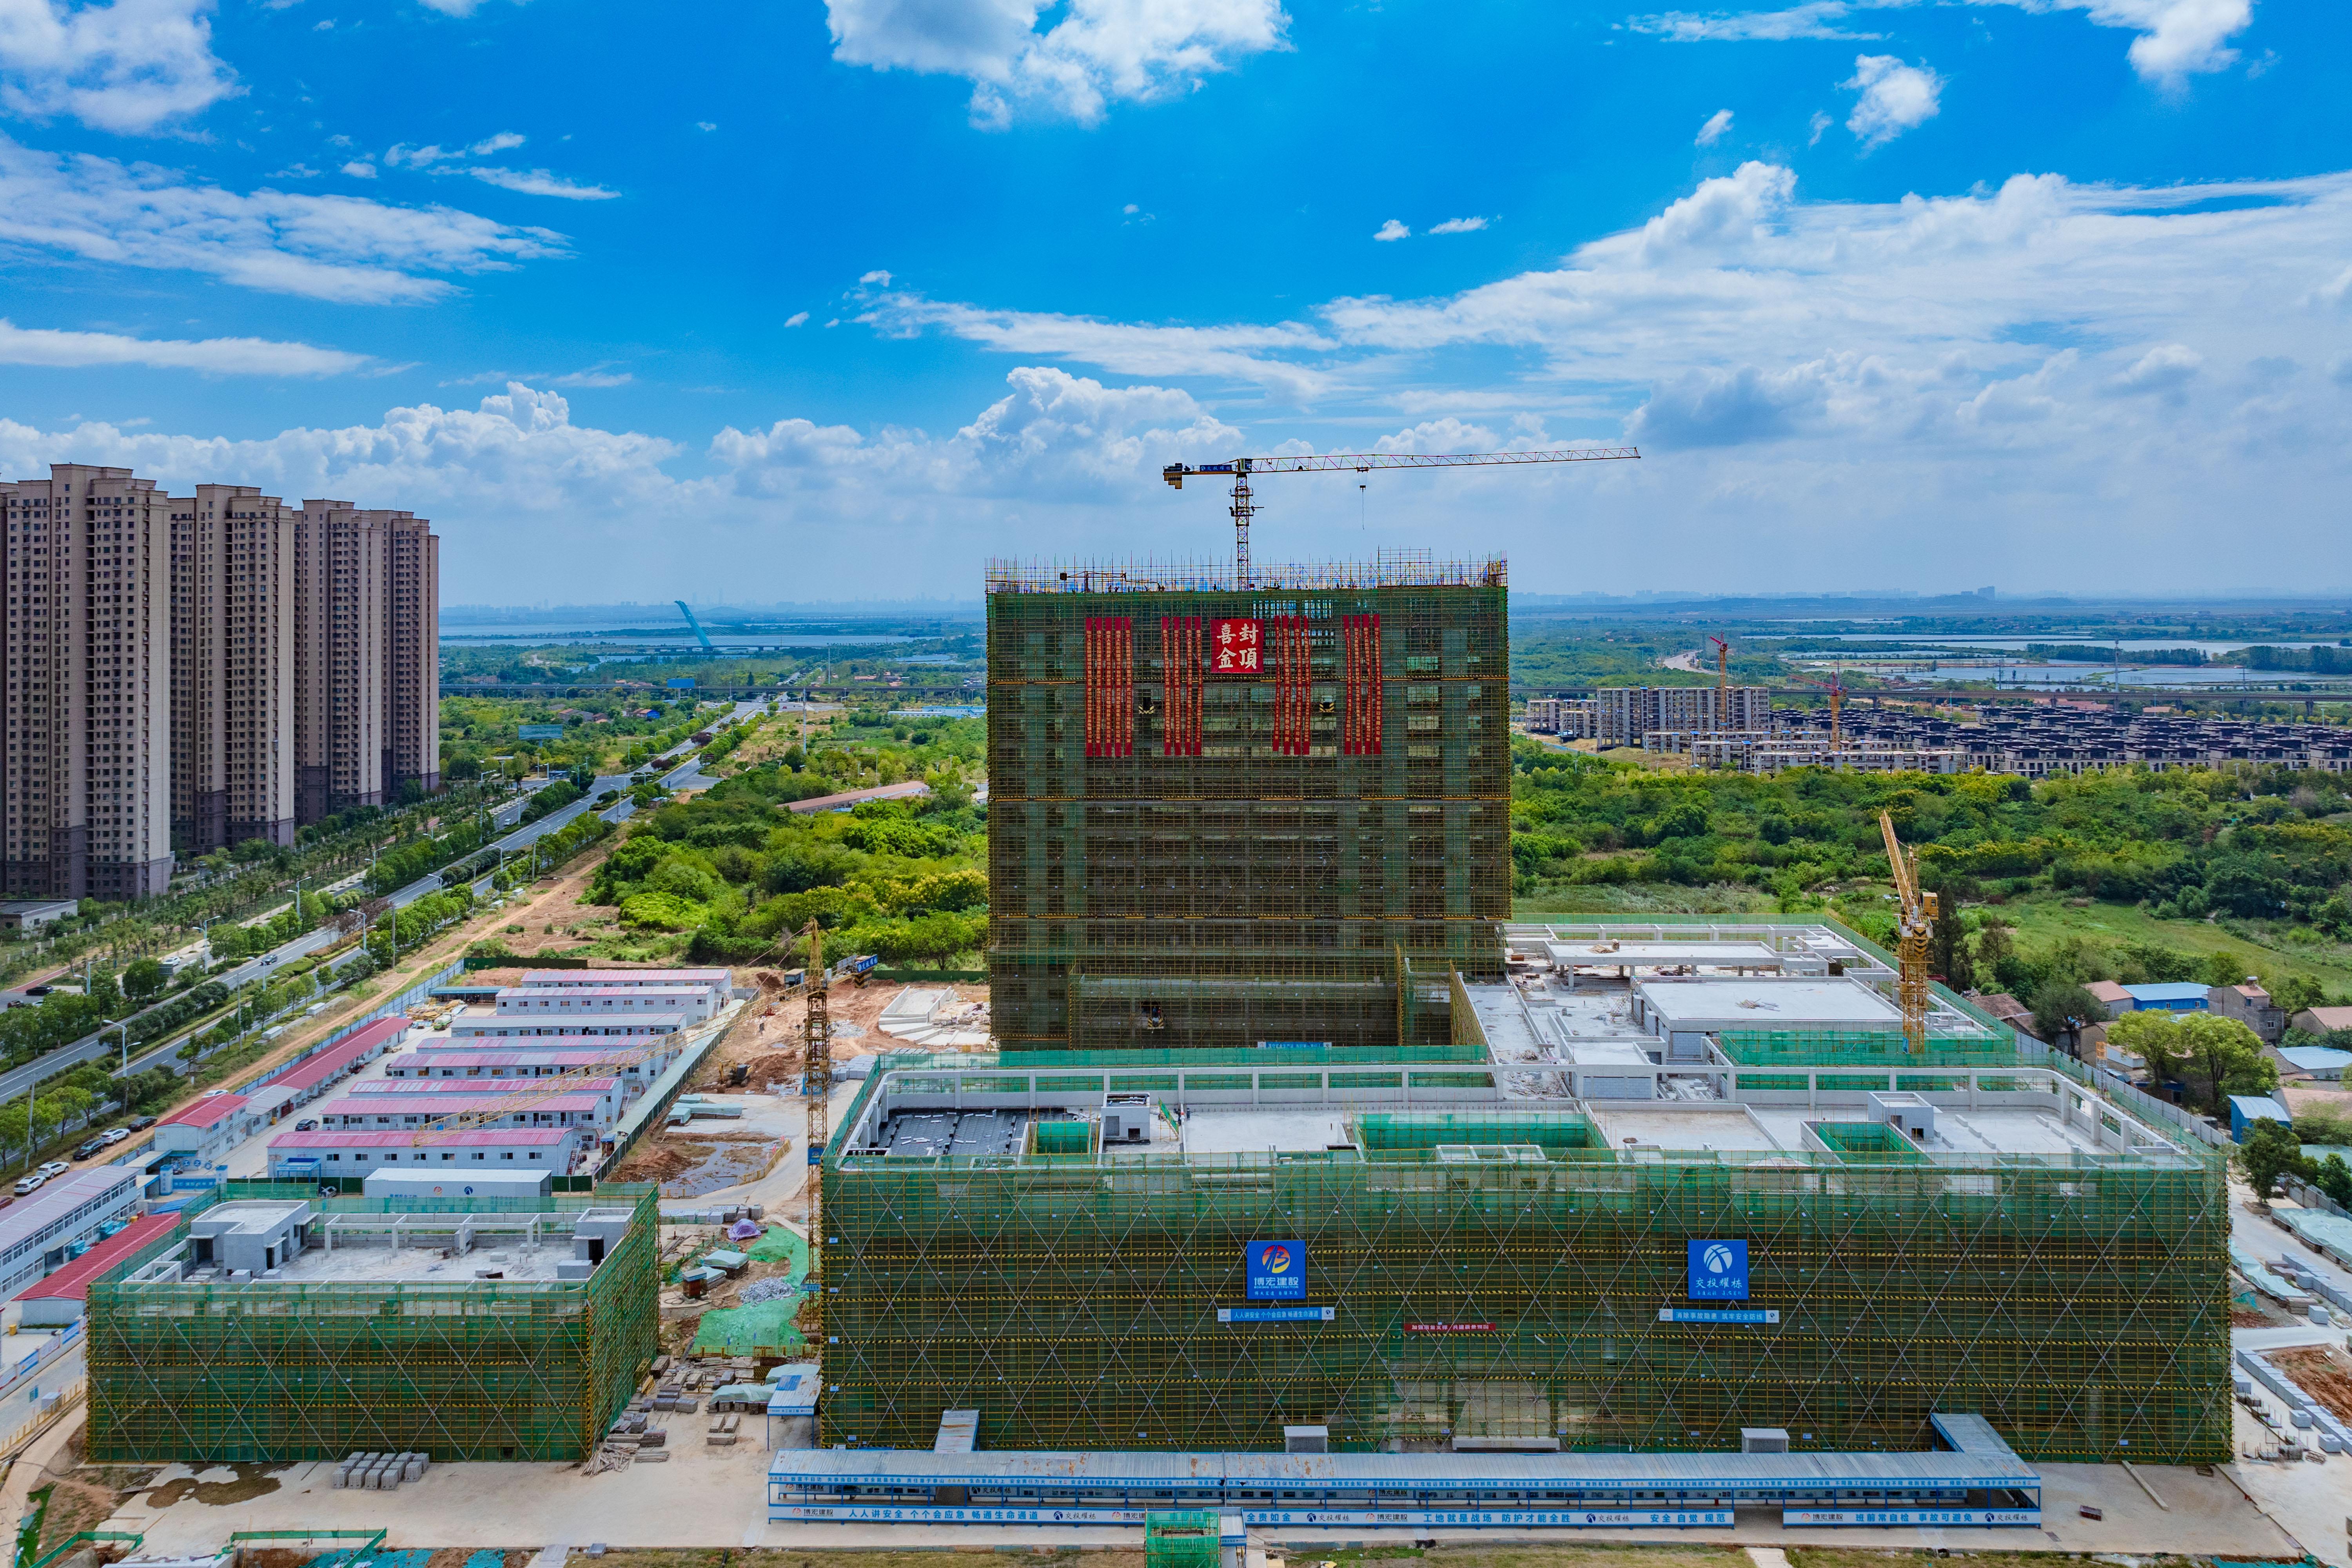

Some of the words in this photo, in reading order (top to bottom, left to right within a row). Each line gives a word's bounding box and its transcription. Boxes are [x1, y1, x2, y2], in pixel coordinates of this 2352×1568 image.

[1254, 1277, 1299, 1286] 博宏建設
[1695, 1277, 1742, 1289] 交投耀栋
[1676, 1311, 1718, 1319] 消除事故隐患
[849, 1509, 903, 1519] 人人讲安全
[911, 1510, 964, 1519] 个个会应急
[972, 1510, 1038, 1520] 畅通生命通道
[1423, 1514, 1492, 1523] 工地就是战场
[1502, 1514, 1570, 1523] 防护才能全胜
[1650, 1514, 1671, 1523] 安全
[1678, 1514, 1698, 1523] 自觉
[1705, 1514, 1726, 1523] 规范
[1855, 1514, 1909, 1522] 班前常自检
[1919, 1513, 1973, 1522] 事故可避免
